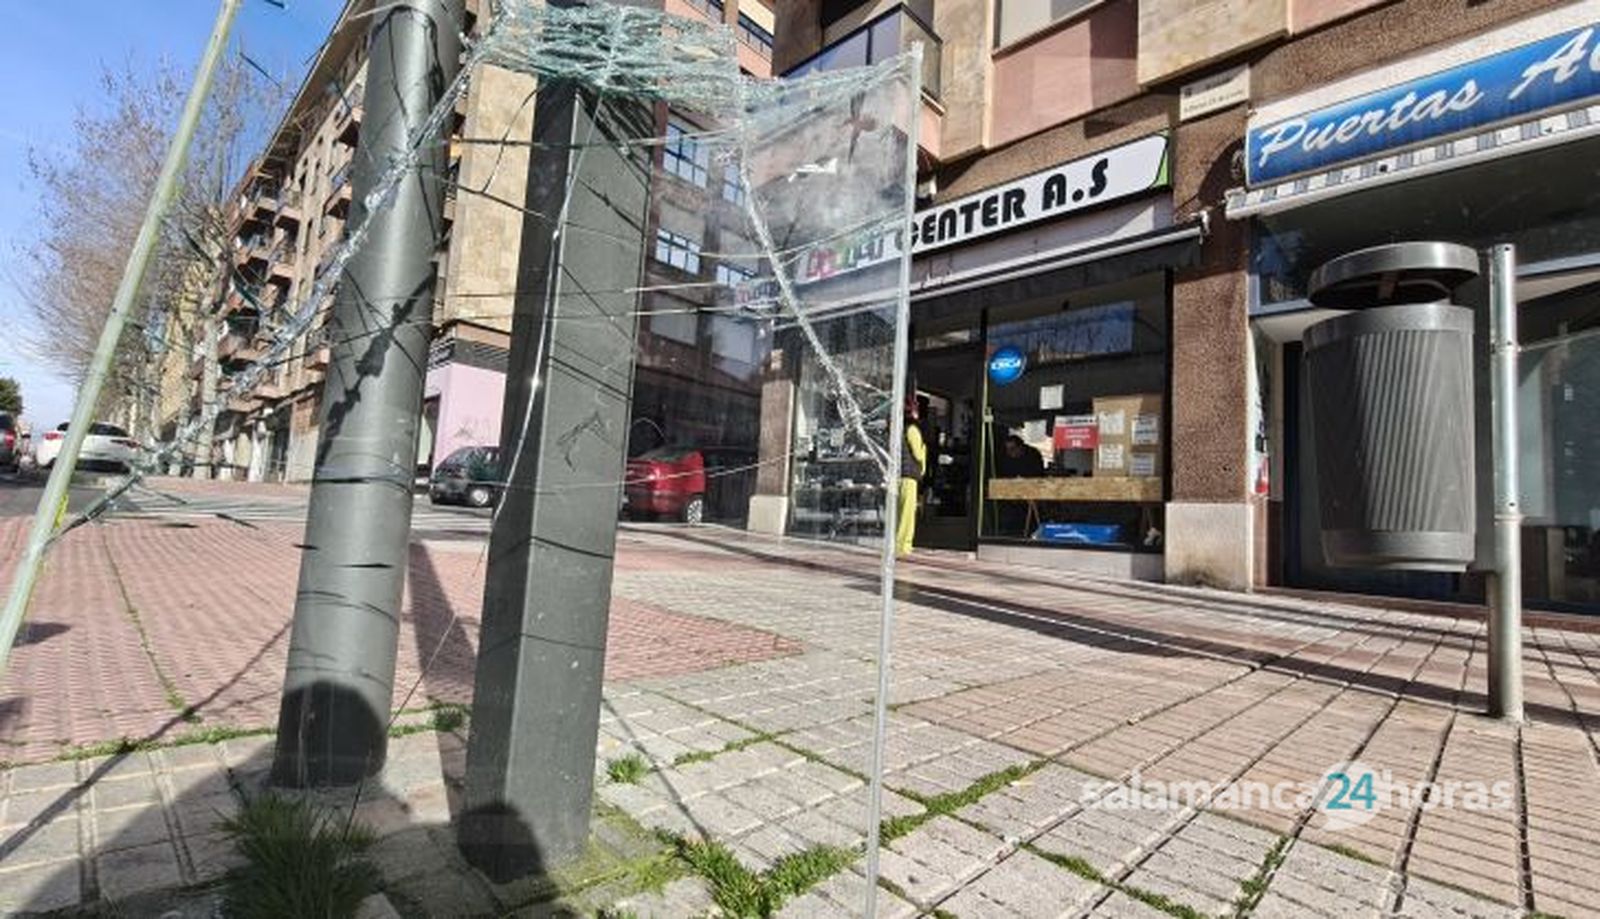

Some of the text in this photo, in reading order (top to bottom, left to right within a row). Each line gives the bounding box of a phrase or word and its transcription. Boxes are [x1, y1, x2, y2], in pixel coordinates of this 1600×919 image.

[1259, 27, 1600, 168] Puertas A
[895, 157, 1109, 251] CENTER A.S
